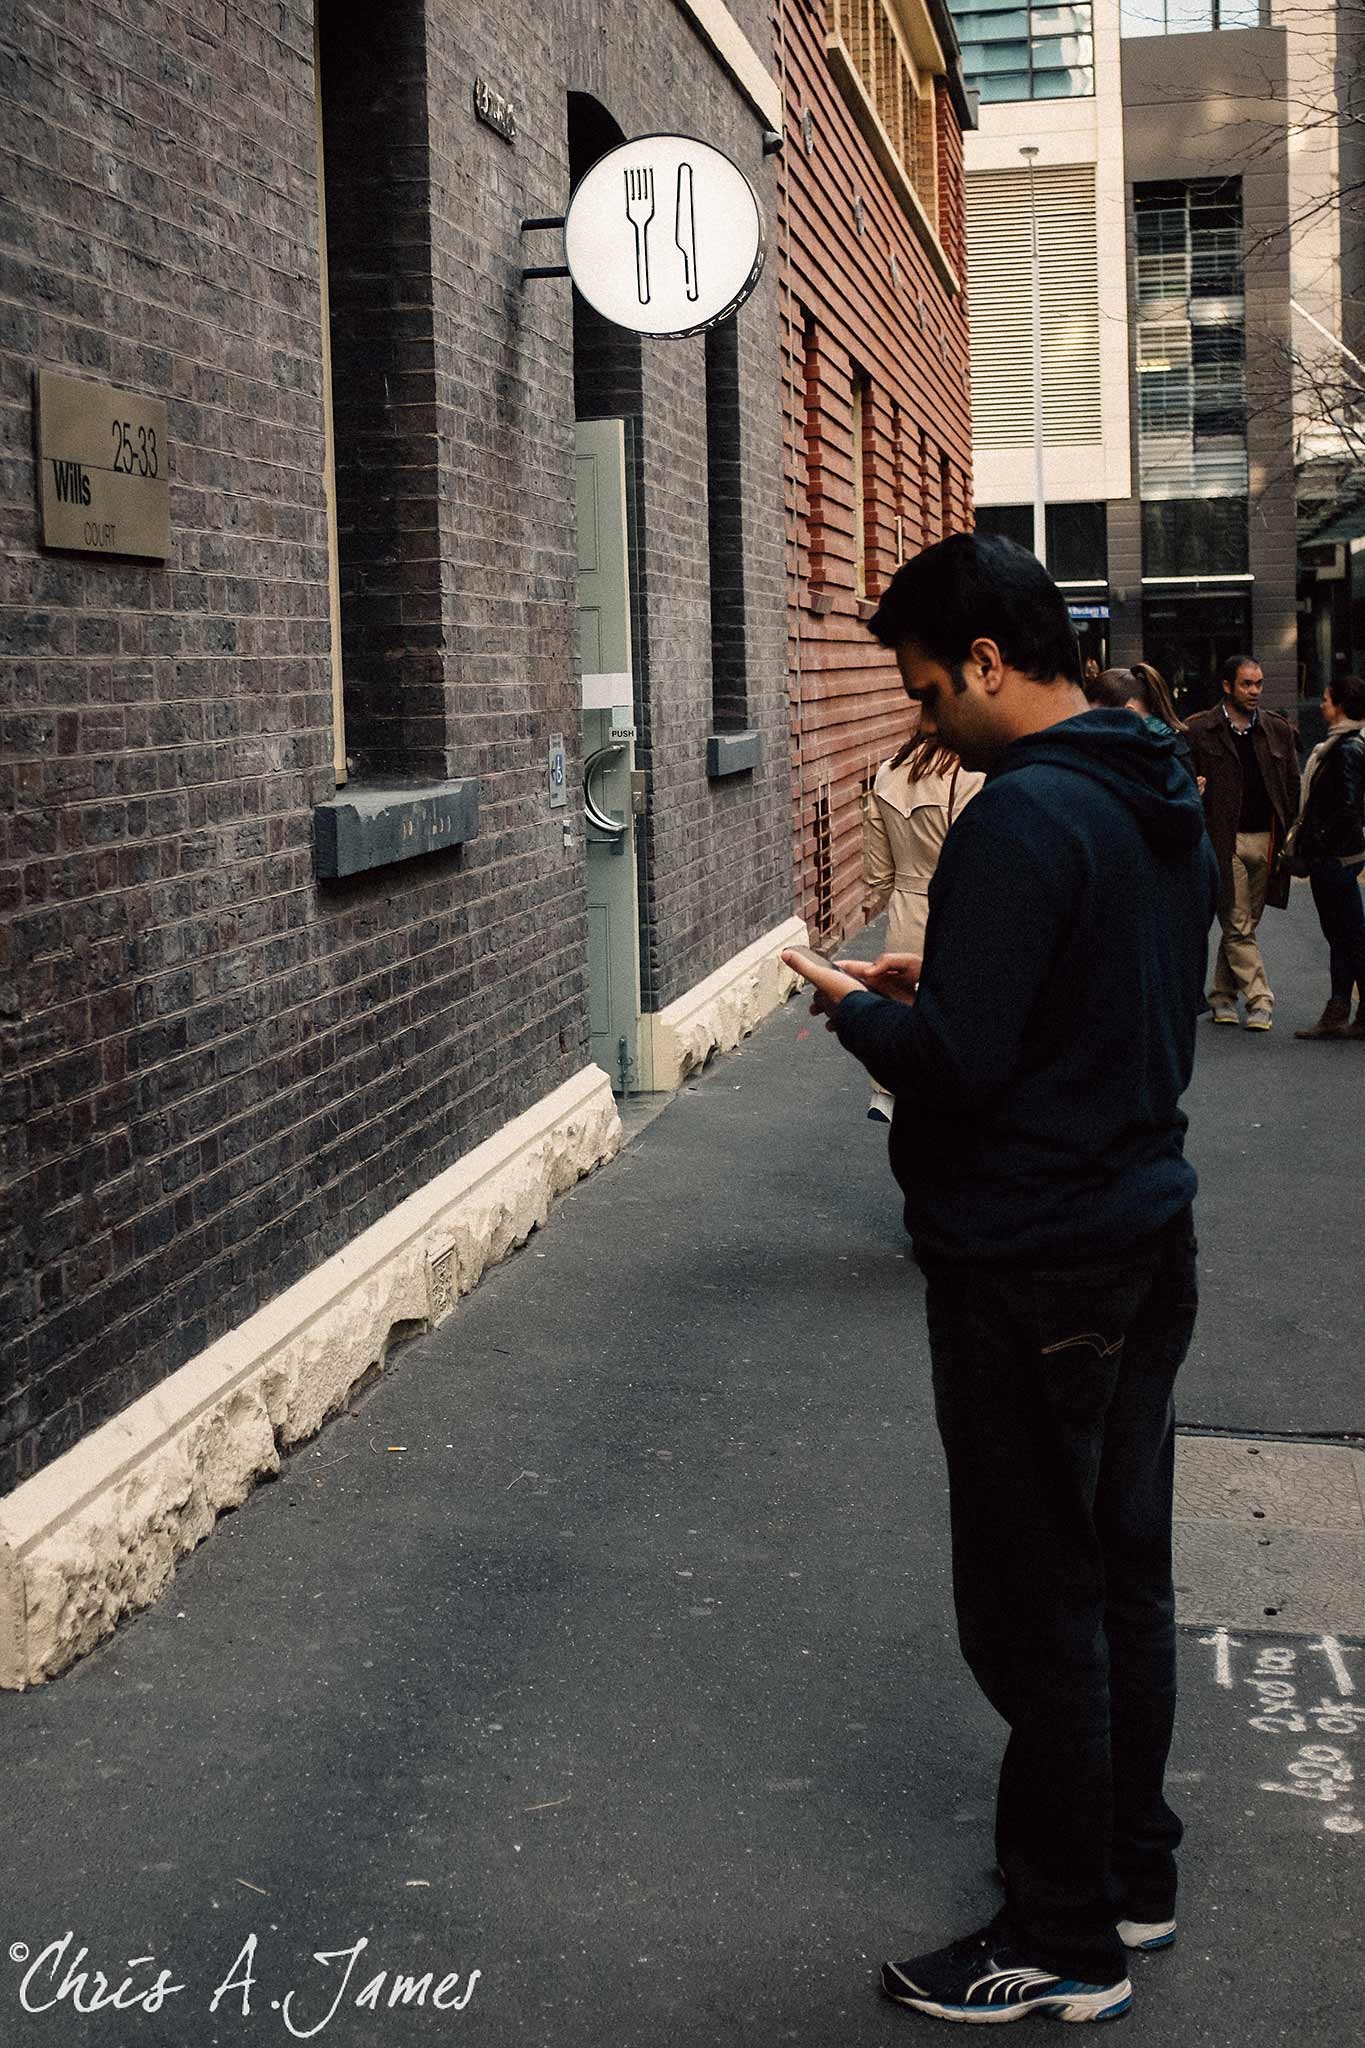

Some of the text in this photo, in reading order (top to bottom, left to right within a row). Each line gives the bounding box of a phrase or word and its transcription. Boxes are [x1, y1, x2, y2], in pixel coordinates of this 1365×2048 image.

[112, 419, 158, 479] 25-33
[53, 459, 91, 506] Wills
[84, 522, 116, 547] COURT
[611, 730, 634, 738] PUSH
